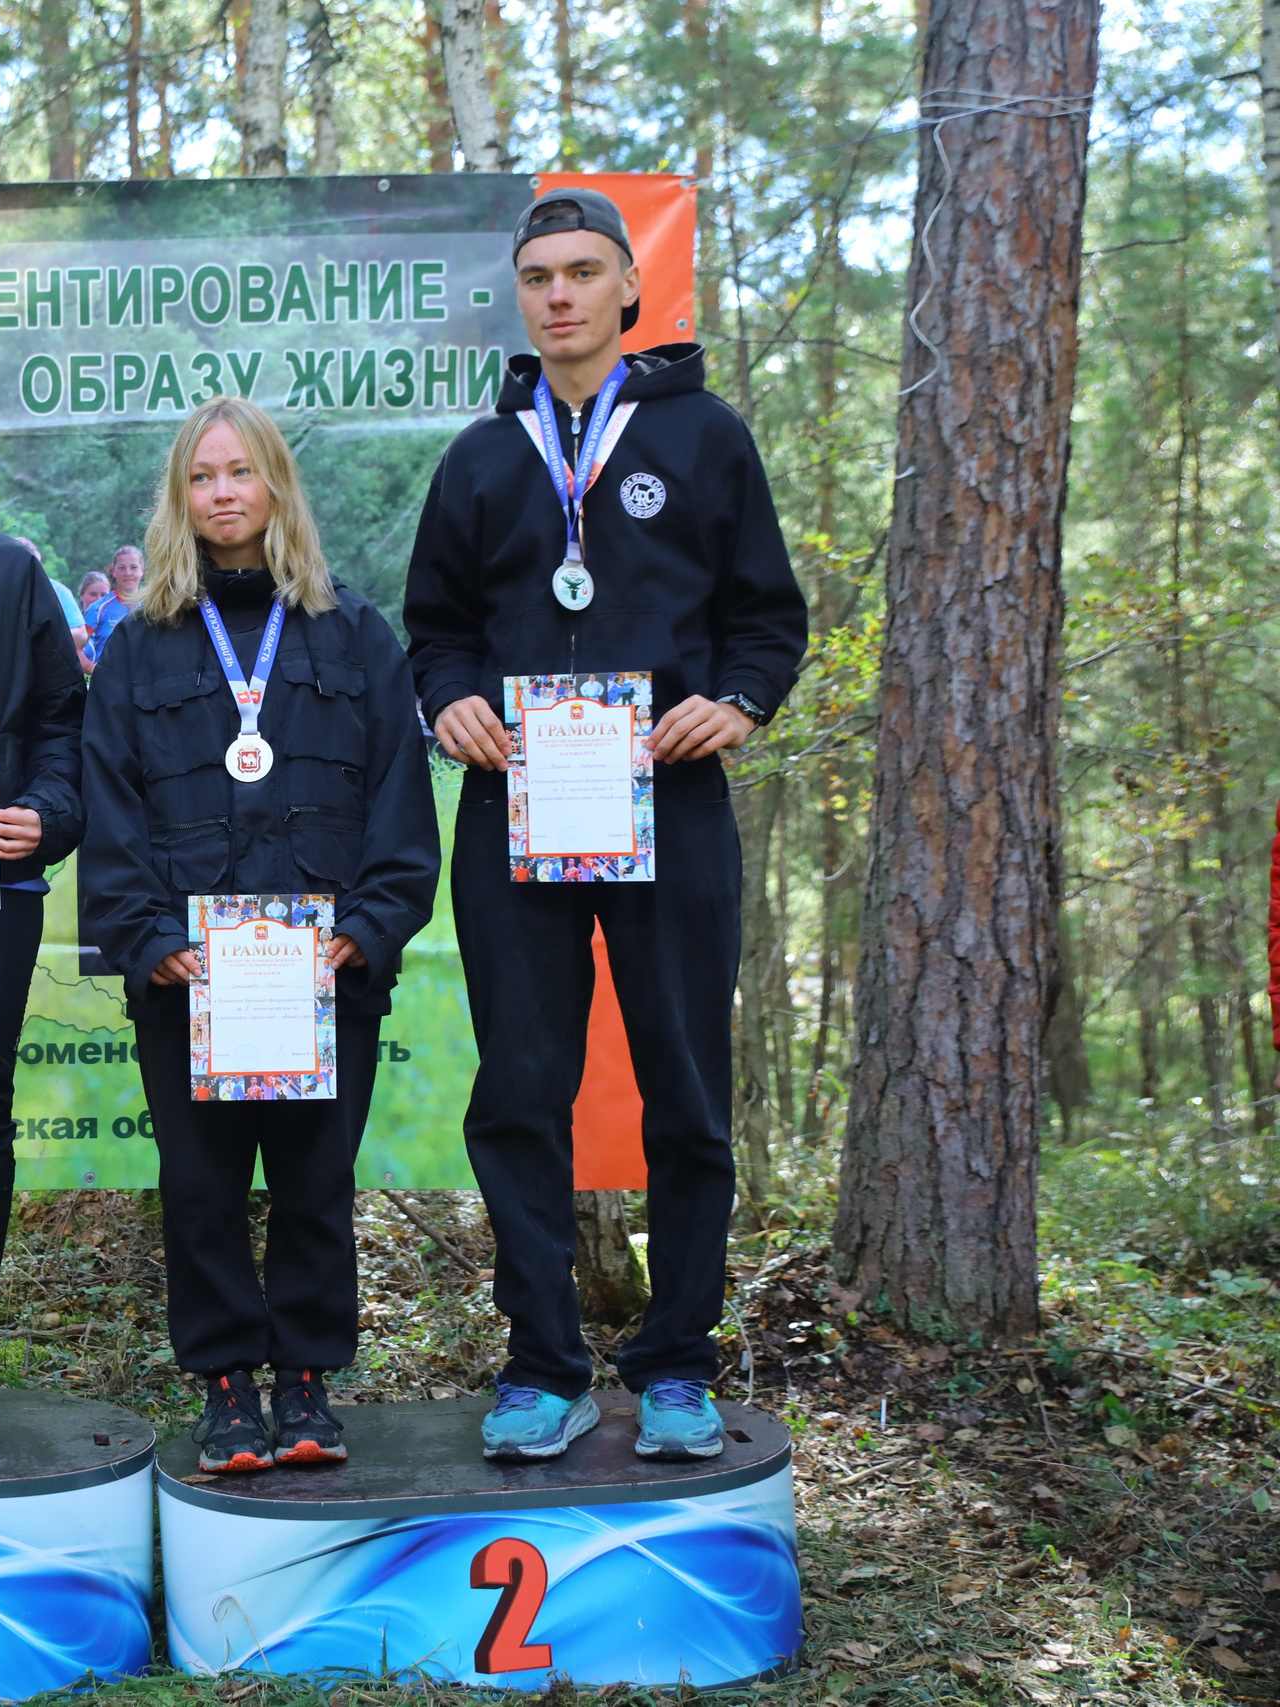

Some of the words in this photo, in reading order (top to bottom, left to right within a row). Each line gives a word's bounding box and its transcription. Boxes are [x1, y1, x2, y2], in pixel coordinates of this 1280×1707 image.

[21, 350, 264, 415] ОБРАЗУ
[284, 348, 503, 411] ЖИЗНИ
[205, 607, 235, 667] ЧЕЛЯБИНСКАЯ
[260, 623, 278, 663] ОБЛАСТЬ
[536, 722, 619, 737] ГРАМОТА
[220, 943, 303, 957] ГРАМОТА
[470, 1537, 553, 1674] 2
